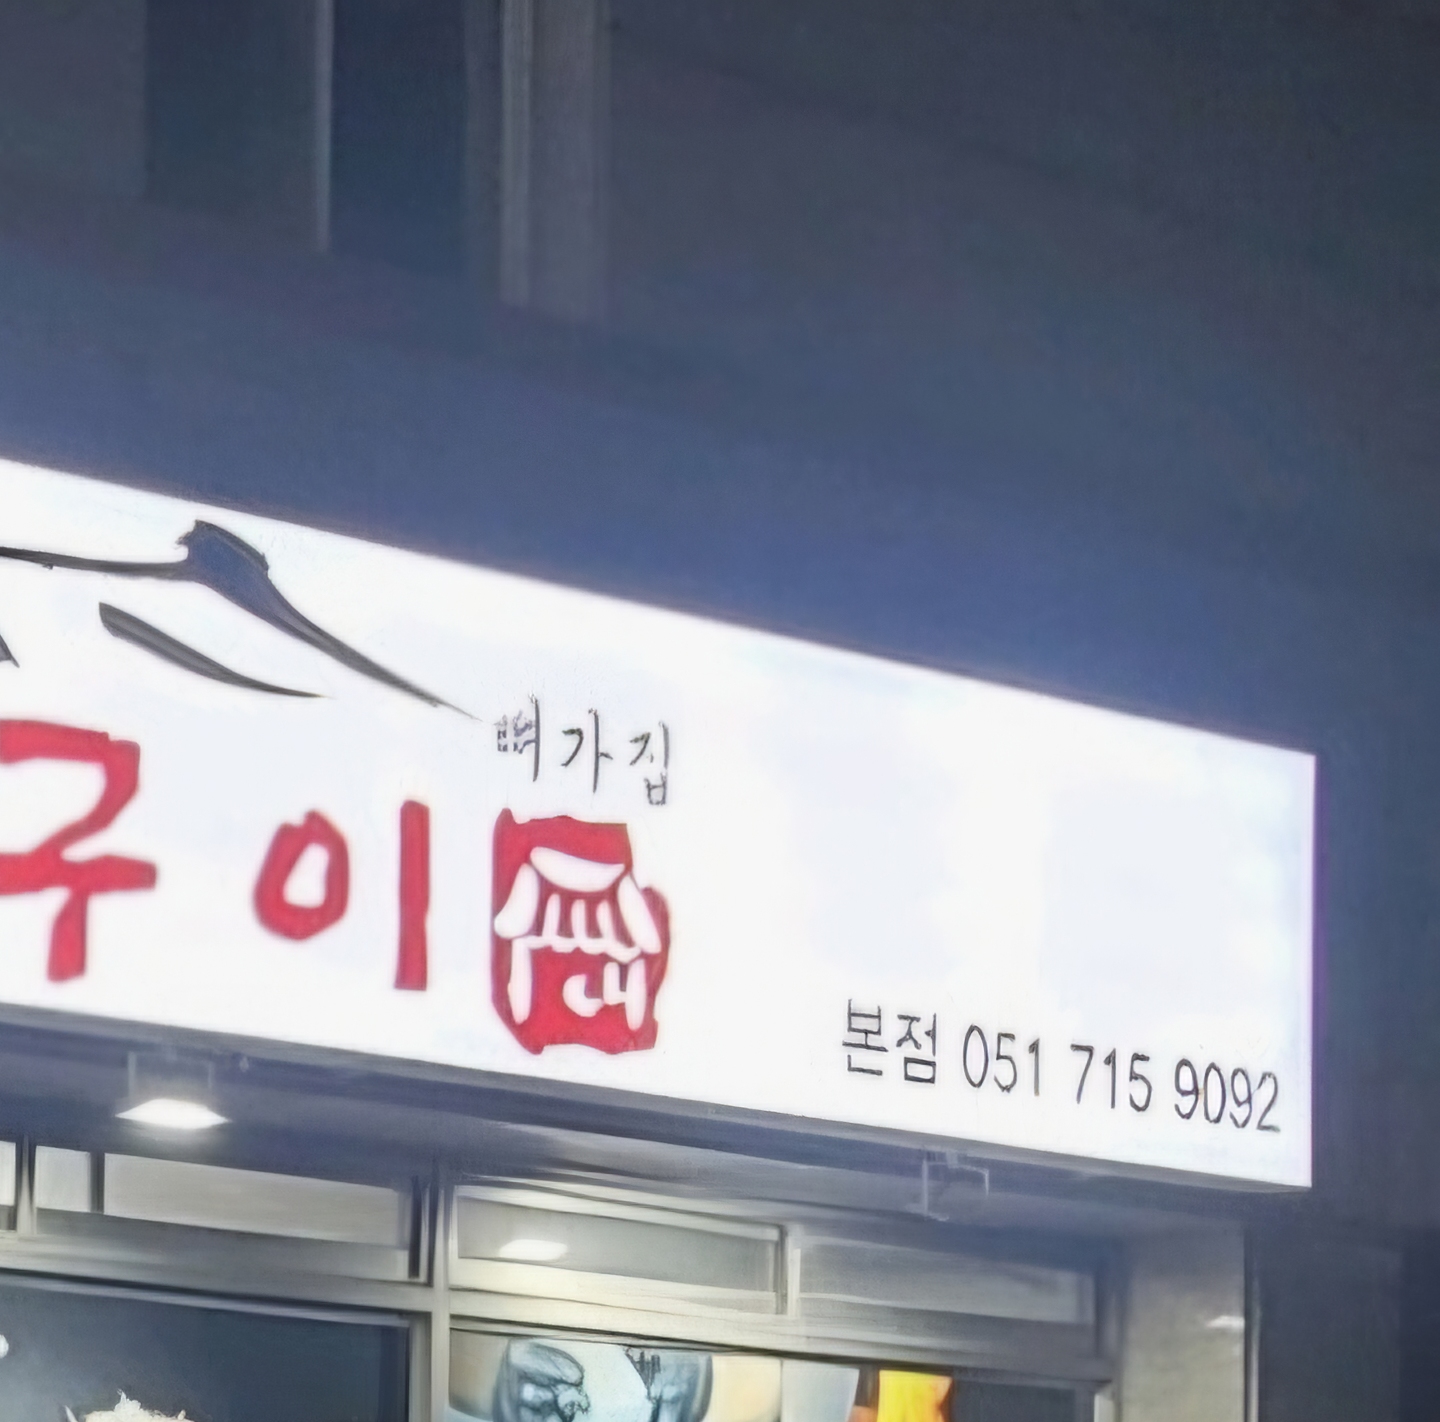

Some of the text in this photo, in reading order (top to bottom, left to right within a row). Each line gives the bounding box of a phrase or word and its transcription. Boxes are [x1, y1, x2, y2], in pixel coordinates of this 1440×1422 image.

[842, 998, 1280, 1132] 본점 051 715 9092
